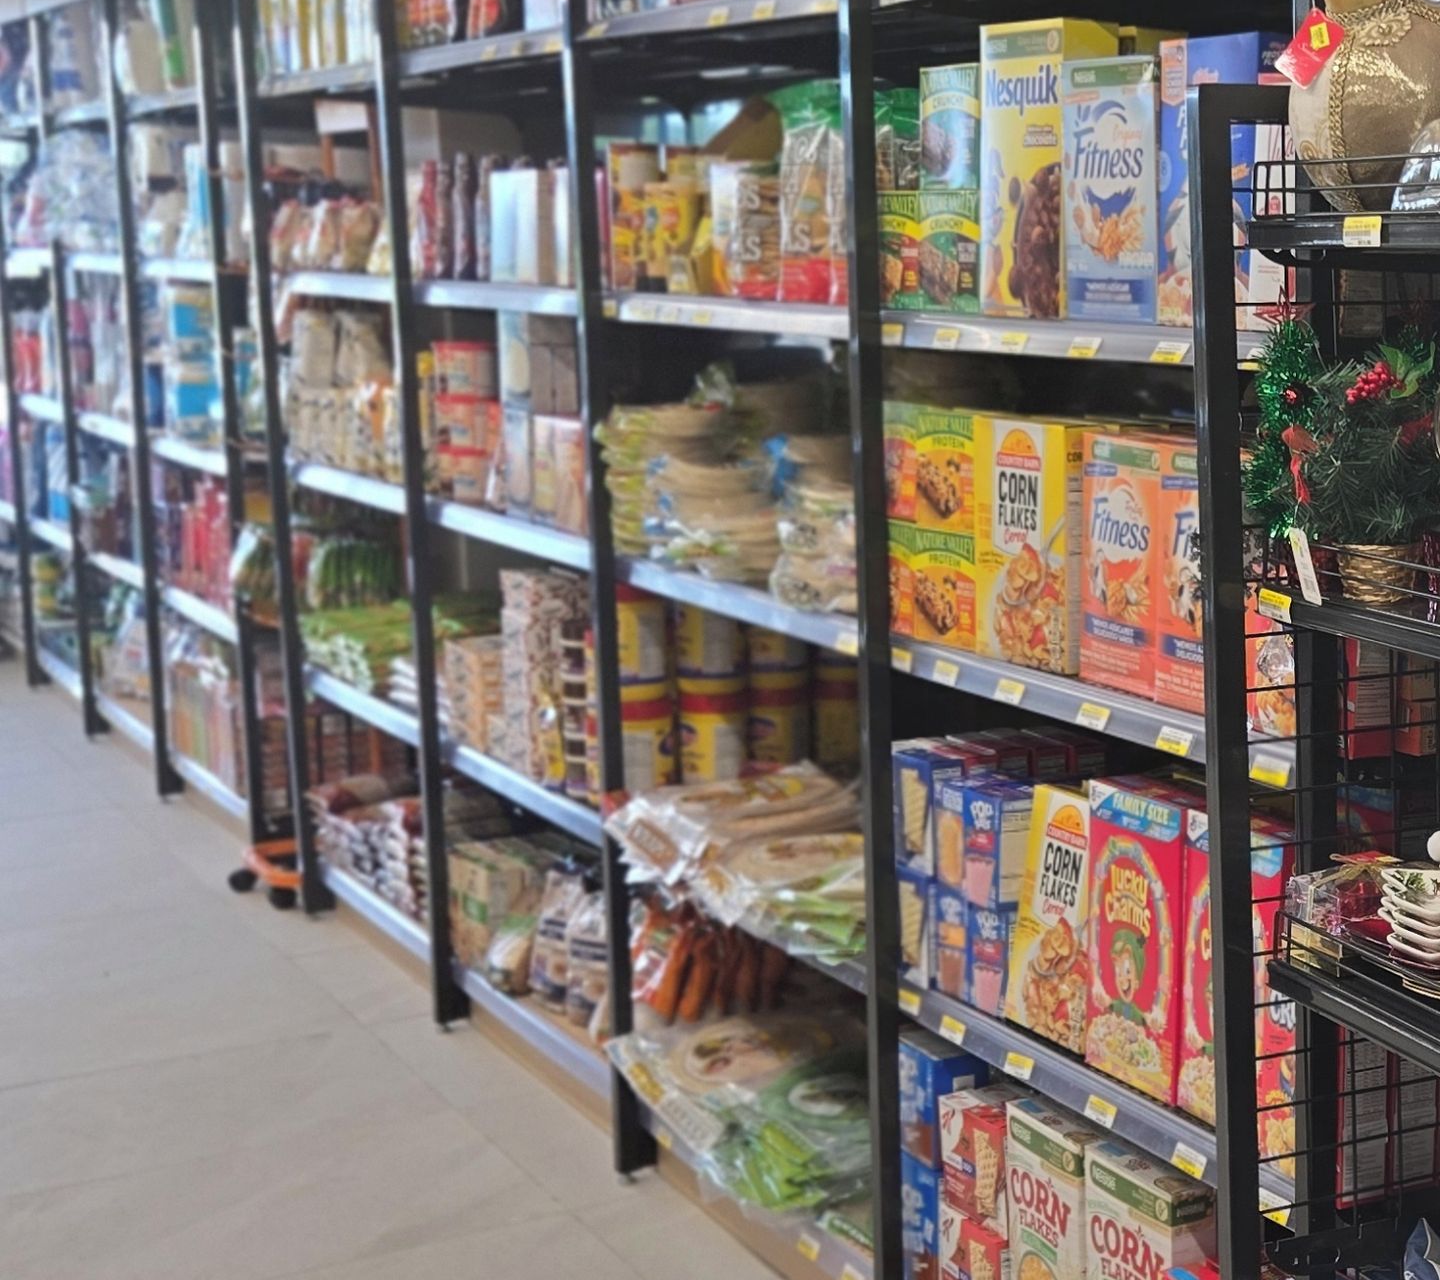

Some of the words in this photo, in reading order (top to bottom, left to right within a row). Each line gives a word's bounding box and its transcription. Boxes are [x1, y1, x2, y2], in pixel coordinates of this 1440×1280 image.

[984, 64, 1059, 117] Nesquik
[1072, 127, 1144, 179] Fitness
[929, 218, 964, 232] CRUNCHY
[931, 435, 965, 449] PROTEIN
[998, 471, 1038, 507] CORN
[998, 503, 1037, 532] FLAKES
[1091, 496, 1150, 552] Fitness
[928, 553, 961, 567] PROTEIN
[1113, 791, 1146, 816] FAMILY
[1148, 803, 1169, 823] SIZE
[1043, 842, 1083, 885] CORN
[1040, 874, 1077, 908] FLAKES
[1111, 864, 1149, 905] Lucky
[1105, 892, 1151, 938] Charms
[1009, 1167, 1071, 1237] CORN
[1018, 1208, 1059, 1249] FLAKES
